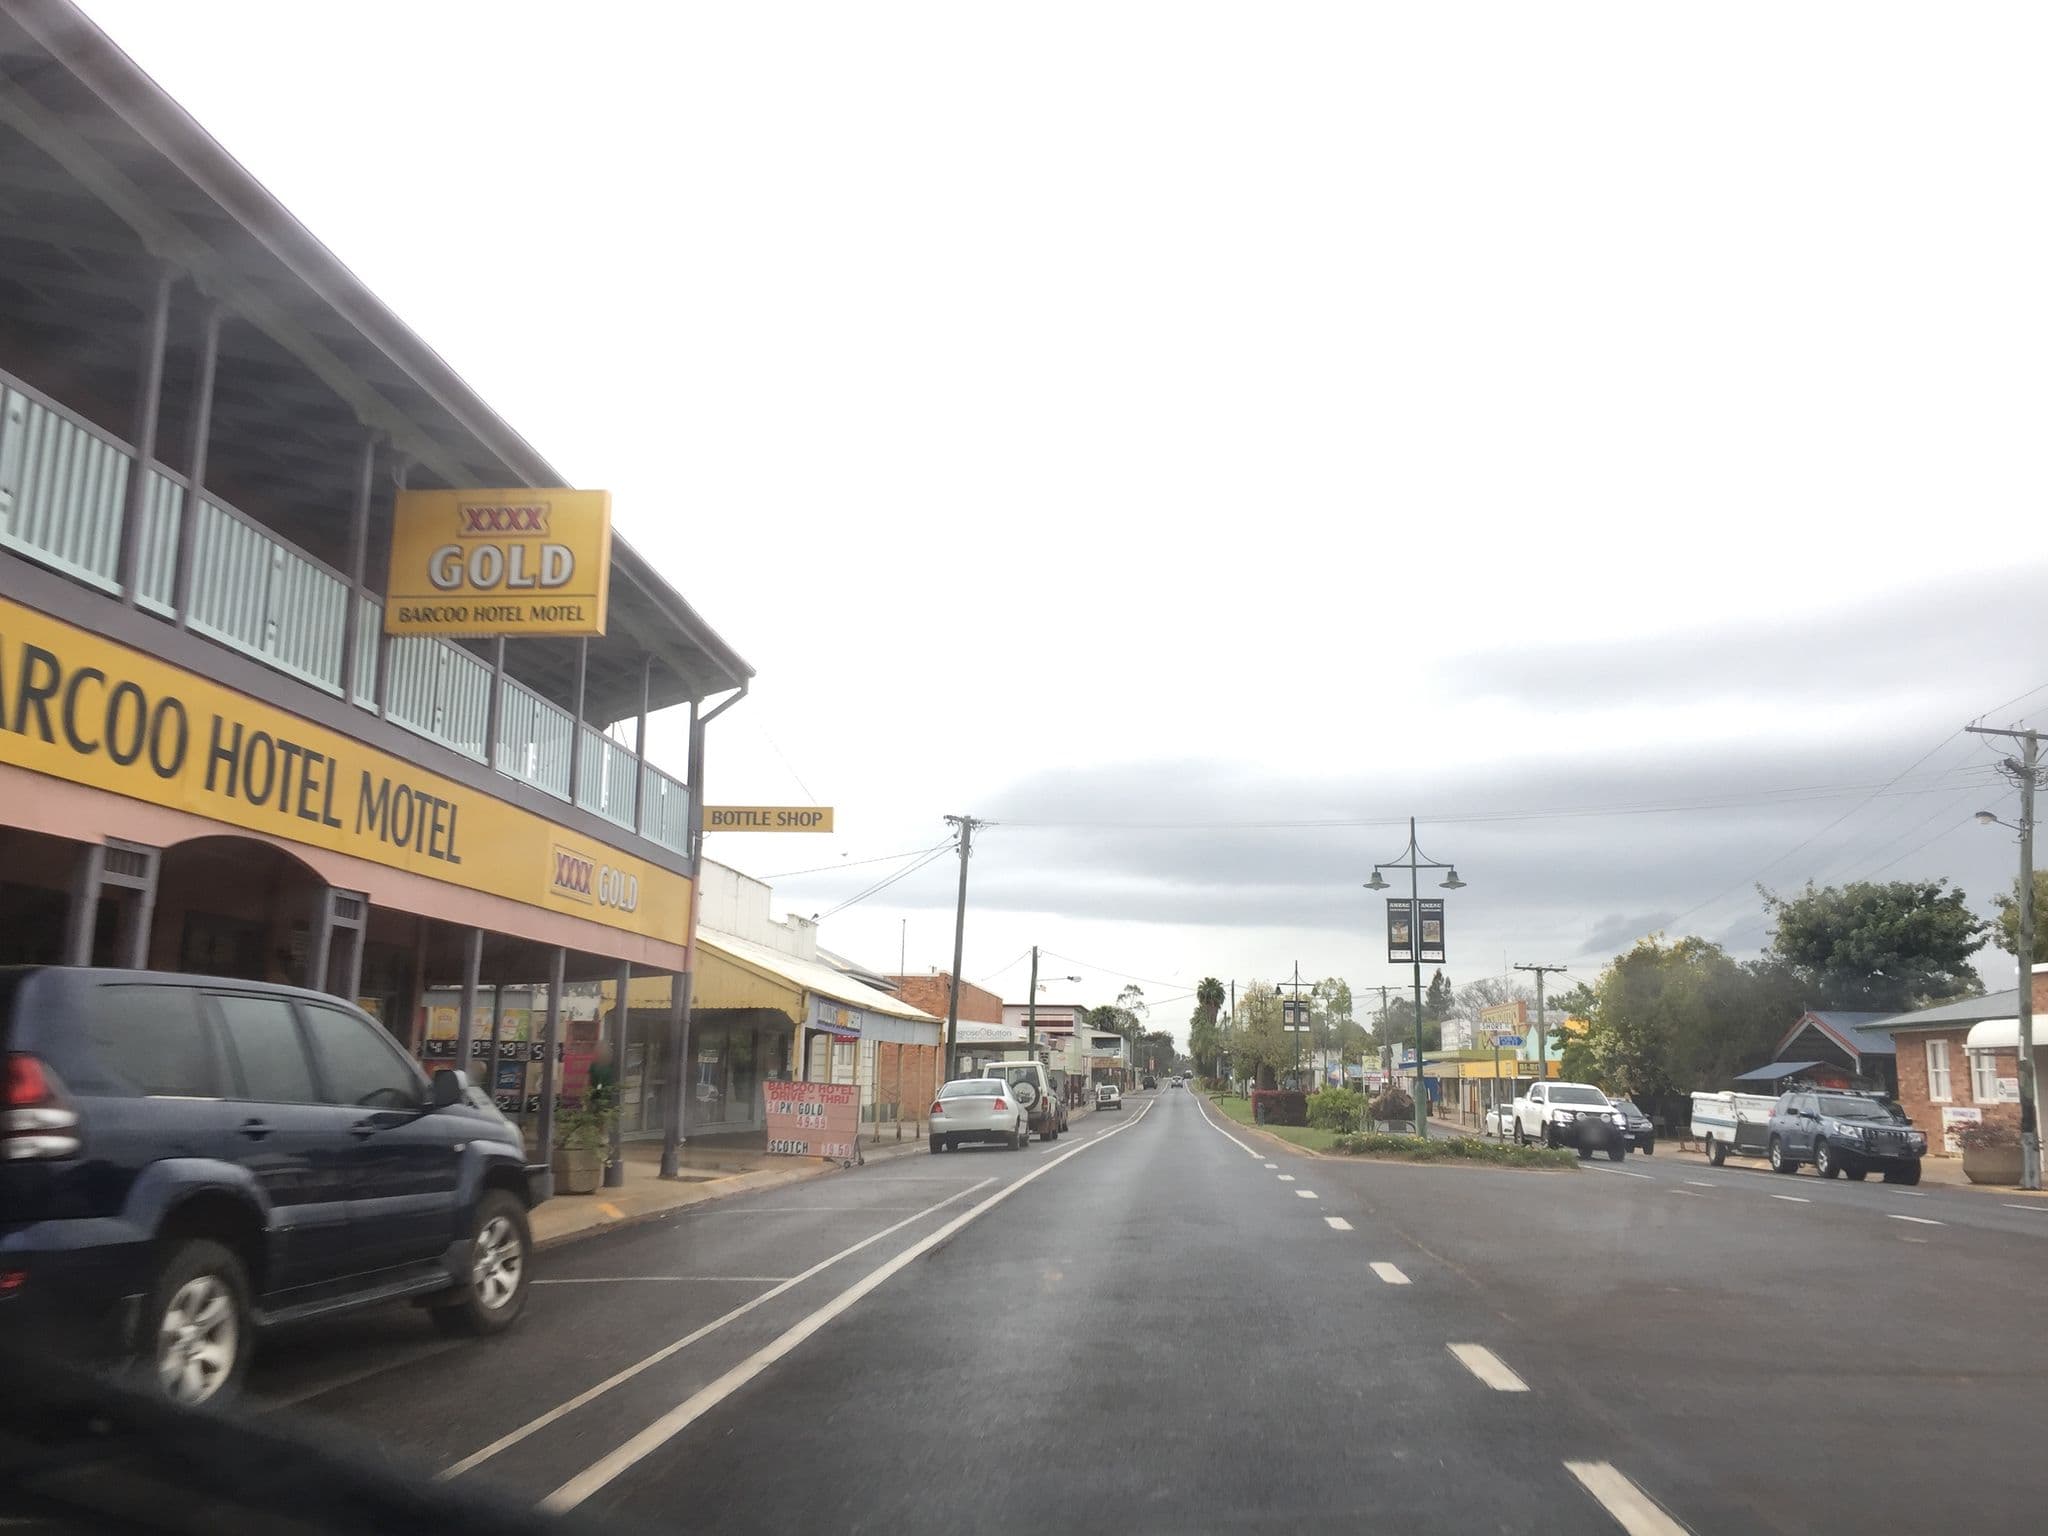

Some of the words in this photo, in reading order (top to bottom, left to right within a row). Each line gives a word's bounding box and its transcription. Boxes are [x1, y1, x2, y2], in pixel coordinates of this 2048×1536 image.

[466, 507, 544, 532] XXXX
[428, 543, 575, 590] GOLD
[398, 605, 467, 622] BARCOO
[472, 605, 524, 622] HOTEL
[529, 605, 585, 622] MOTEL
[205, 715, 342, 828] HOTEL
[356, 771, 462, 865] MOTEL
[711, 810, 772, 826] BOTTLE
[777, 810, 823, 826] SHOP
[553, 850, 594, 895] XXXX
[597, 864, 640, 913] GOLD
[768, 1081, 816, 1094] BARCOO
[818, 1084, 855, 1096] HOTEL
[771, 1091, 805, 1102] DRIVE
[820, 1094, 850, 1105] THRU
[798, 1102, 824, 1116] GOLD
[769, 1139, 809, 1154] SCOTCH
